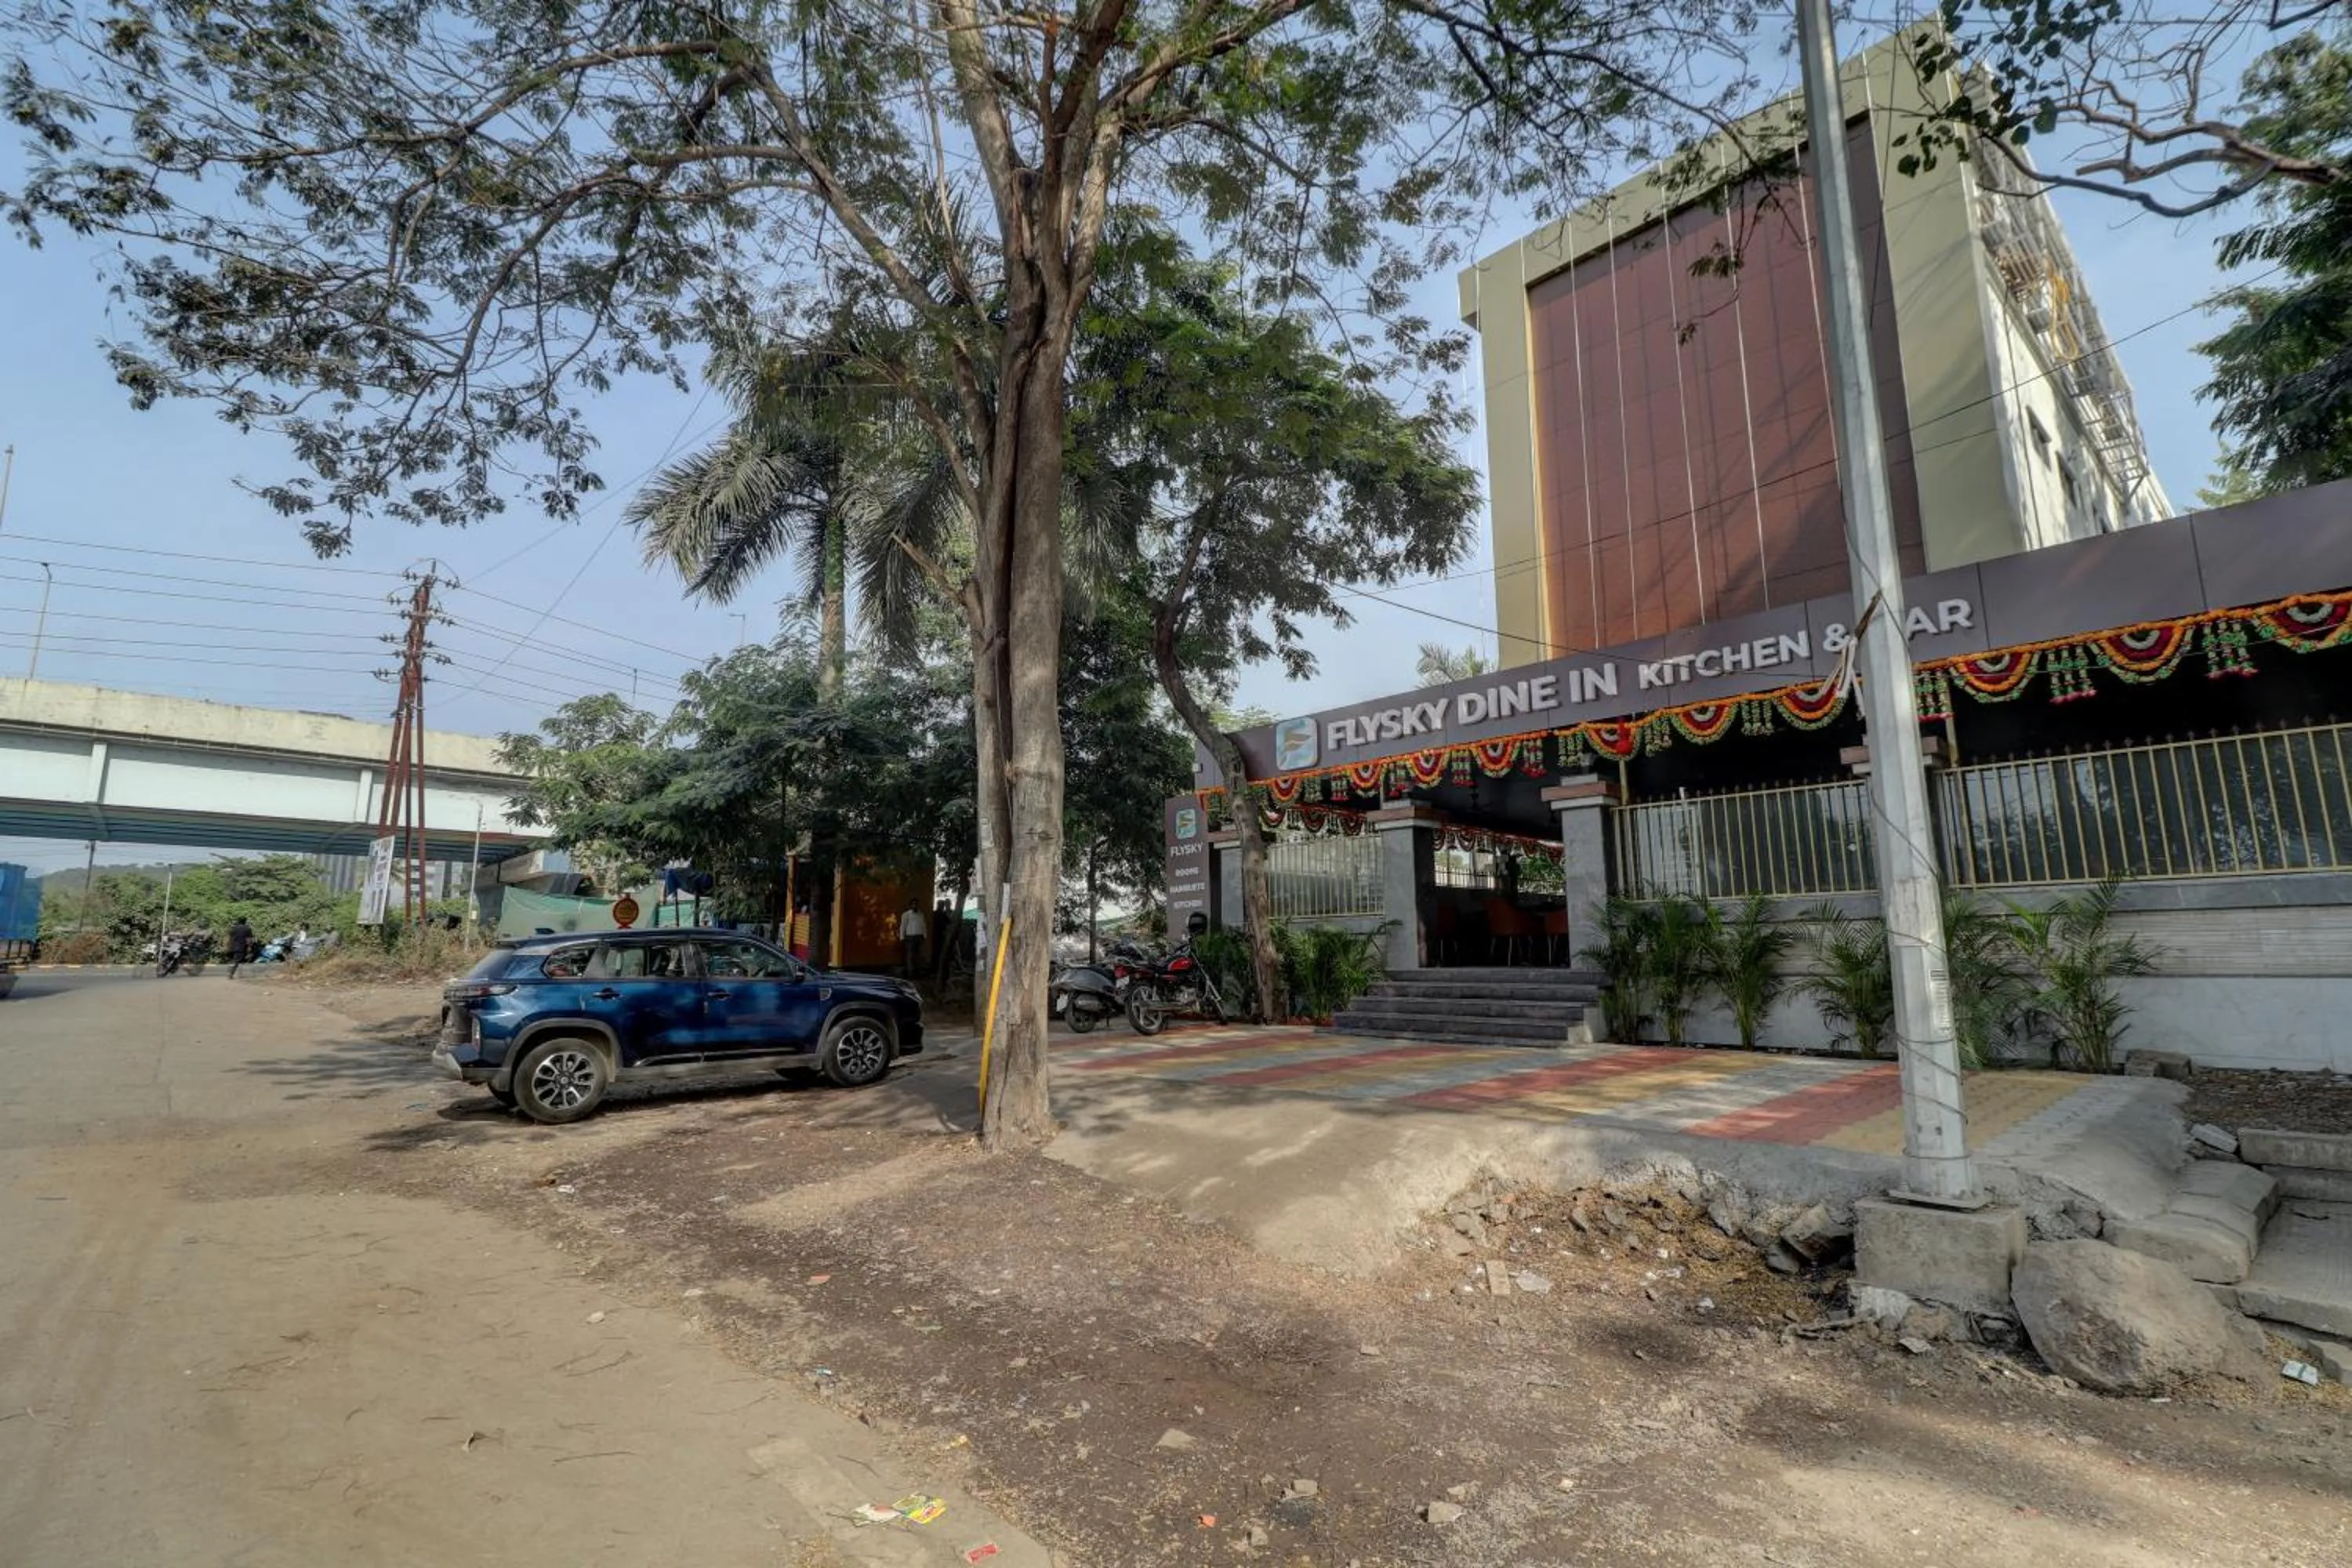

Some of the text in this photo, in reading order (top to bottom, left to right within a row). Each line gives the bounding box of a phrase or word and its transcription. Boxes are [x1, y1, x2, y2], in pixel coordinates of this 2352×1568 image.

[1327, 698, 1449, 750] FLYSKY
[1457, 675, 1559, 724] DINE
[1569, 662, 1617, 702] IN
[1638, 630, 1810, 689] KITCHEN
[1905, 598, 1973, 641] AR
[1171, 842, 1203, 857] FLYSKY
